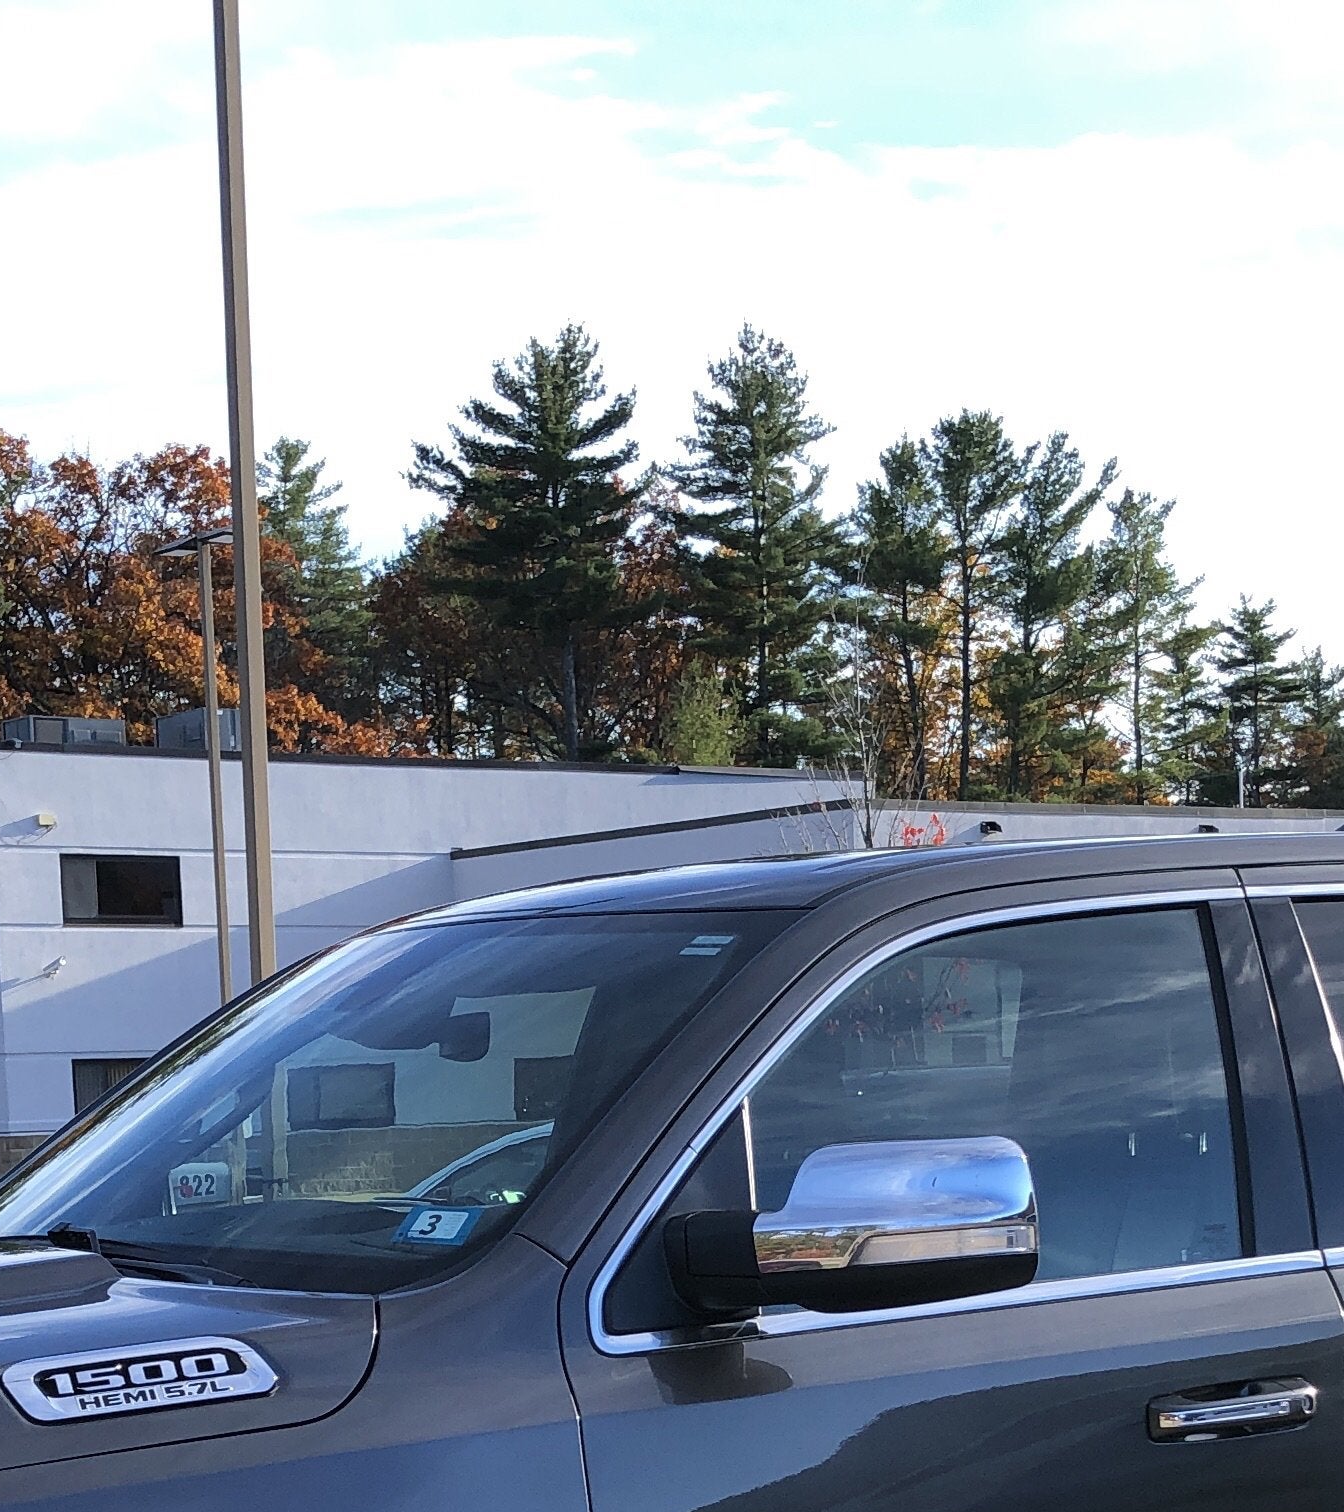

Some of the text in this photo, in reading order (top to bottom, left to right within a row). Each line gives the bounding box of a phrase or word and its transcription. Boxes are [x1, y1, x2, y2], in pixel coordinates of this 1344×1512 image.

[418, 1214, 442, 1236] 3
[44, 1352, 231, 1396] 1500
[78, 1380, 230, 1411] HEMI 5.7L
